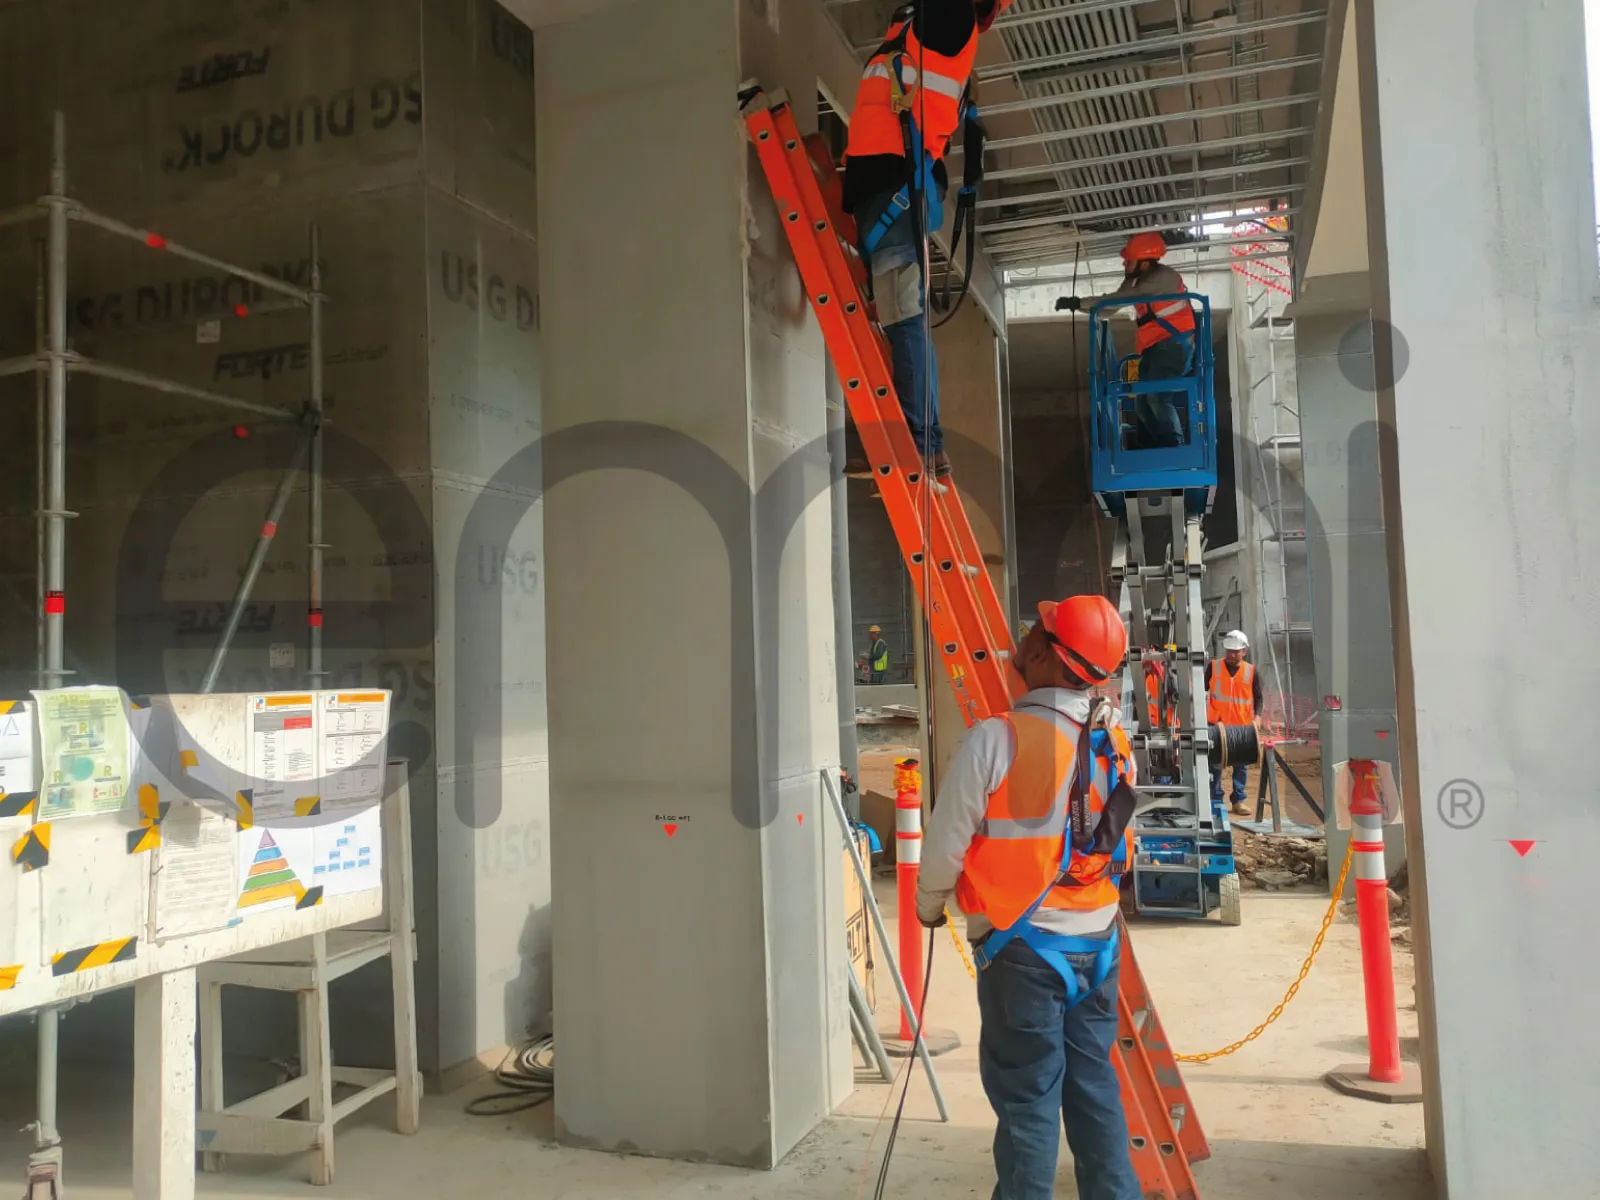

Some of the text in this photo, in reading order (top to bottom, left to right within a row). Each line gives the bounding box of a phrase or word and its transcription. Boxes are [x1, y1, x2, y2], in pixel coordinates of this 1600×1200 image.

[176, 46, 272, 94] FORTE
[442, 250, 506, 322] USG
[213, 343, 311, 382] FORTE
[478, 542, 538, 596] USG
[481, 818, 542, 877] USG
